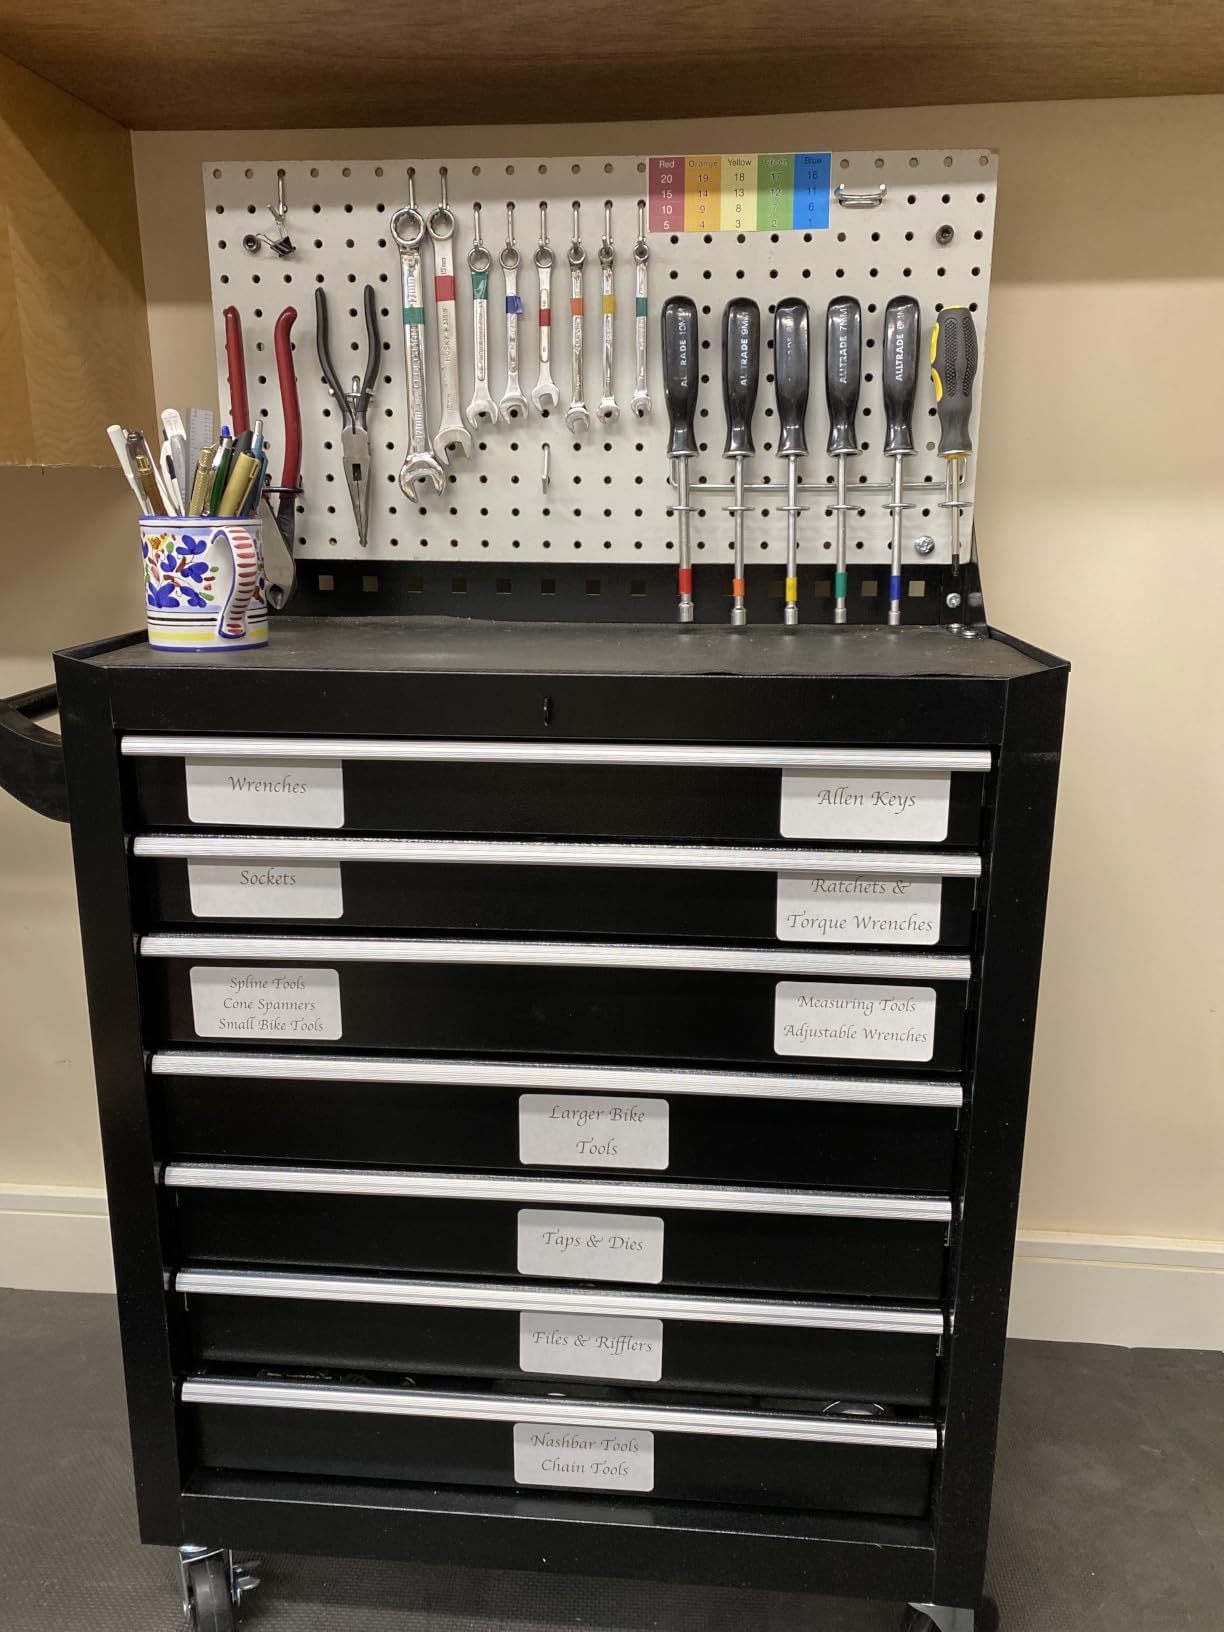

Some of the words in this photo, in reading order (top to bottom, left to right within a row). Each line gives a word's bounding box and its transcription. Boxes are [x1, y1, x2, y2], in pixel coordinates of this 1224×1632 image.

[659, 160, 675, 168] Red
[688, 160, 718, 168] Orange
[727, 158, 752, 166] Yellow
[804, 156, 822, 165] Blue
[660, 174, 673, 184] 20
[698, 174, 709, 183] 19
[734, 173, 745, 182] 18
[771, 172, 782, 181] 17
[661, 189, 673, 199] 15
[698, 190, 708, 198] 14
[734, 189, 745, 197] 13
[771, 187, 781, 197] 12
[808, 187, 817, 196] 11
[661, 205, 673, 215] 10
[700, 205, 706, 214] 9
[735, 204, 742, 213] 8
[772, 203, 778, 212] 7
[663, 220, 670, 230] 5
[699, 220, 705, 229] 4
[735, 219, 742, 229] 3
[771, 219, 778, 228] 2
[839, 307, 848, 331] 7MM
[679, 339, 689, 388] ALRADE
[740, 338, 749, 387] ALTRADE
[895, 333, 905, 382] ALLTRADE
[227, 774, 307, 794] Wrenches
[817, 786, 864, 806] Allen
[871, 791, 917, 815] Keys
[239, 867, 296, 886] Sockets
[810, 875, 887, 895] Ratchets
[892, 879, 912, 895] &
[786, 910, 847, 936] Torque
[854, 912, 934, 932] Wrenches
[229, 974, 268, 994] Spline
[272, 975, 306, 990] Tools
[223, 997, 253, 1010] Cone
[257, 998, 316, 1015] Spanners
[797, 994, 874, 1017] Measuring
[878, 996, 917, 1013] Tools
[218, 1016, 255, 1030] Small
[257, 1016, 286, 1031] Bike
[289, 1017, 324, 1032] Tools
[783, 1022, 857, 1044] Adjustable
[863, 1025, 928, 1043] Wrenches
[548, 1105, 605, 1127] Larger
[608, 1104, 645, 1123] Bike
[575, 1137, 618, 1156] Tools
[542, 1227, 581, 1253] Taps
[586, 1234, 604, 1248] &
[608, 1235, 644, 1251] Dies
[531, 1329, 568, 1346] Files
[573, 1334, 591, 1348] &
[595, 1334, 653, 1356] Rifflers
[529, 1431, 597, 1450] Nashbar
[600, 1435, 640, 1453] Tools
[540, 1457, 585, 1473] Chain
[589, 1459, 630, 1476] Tools
